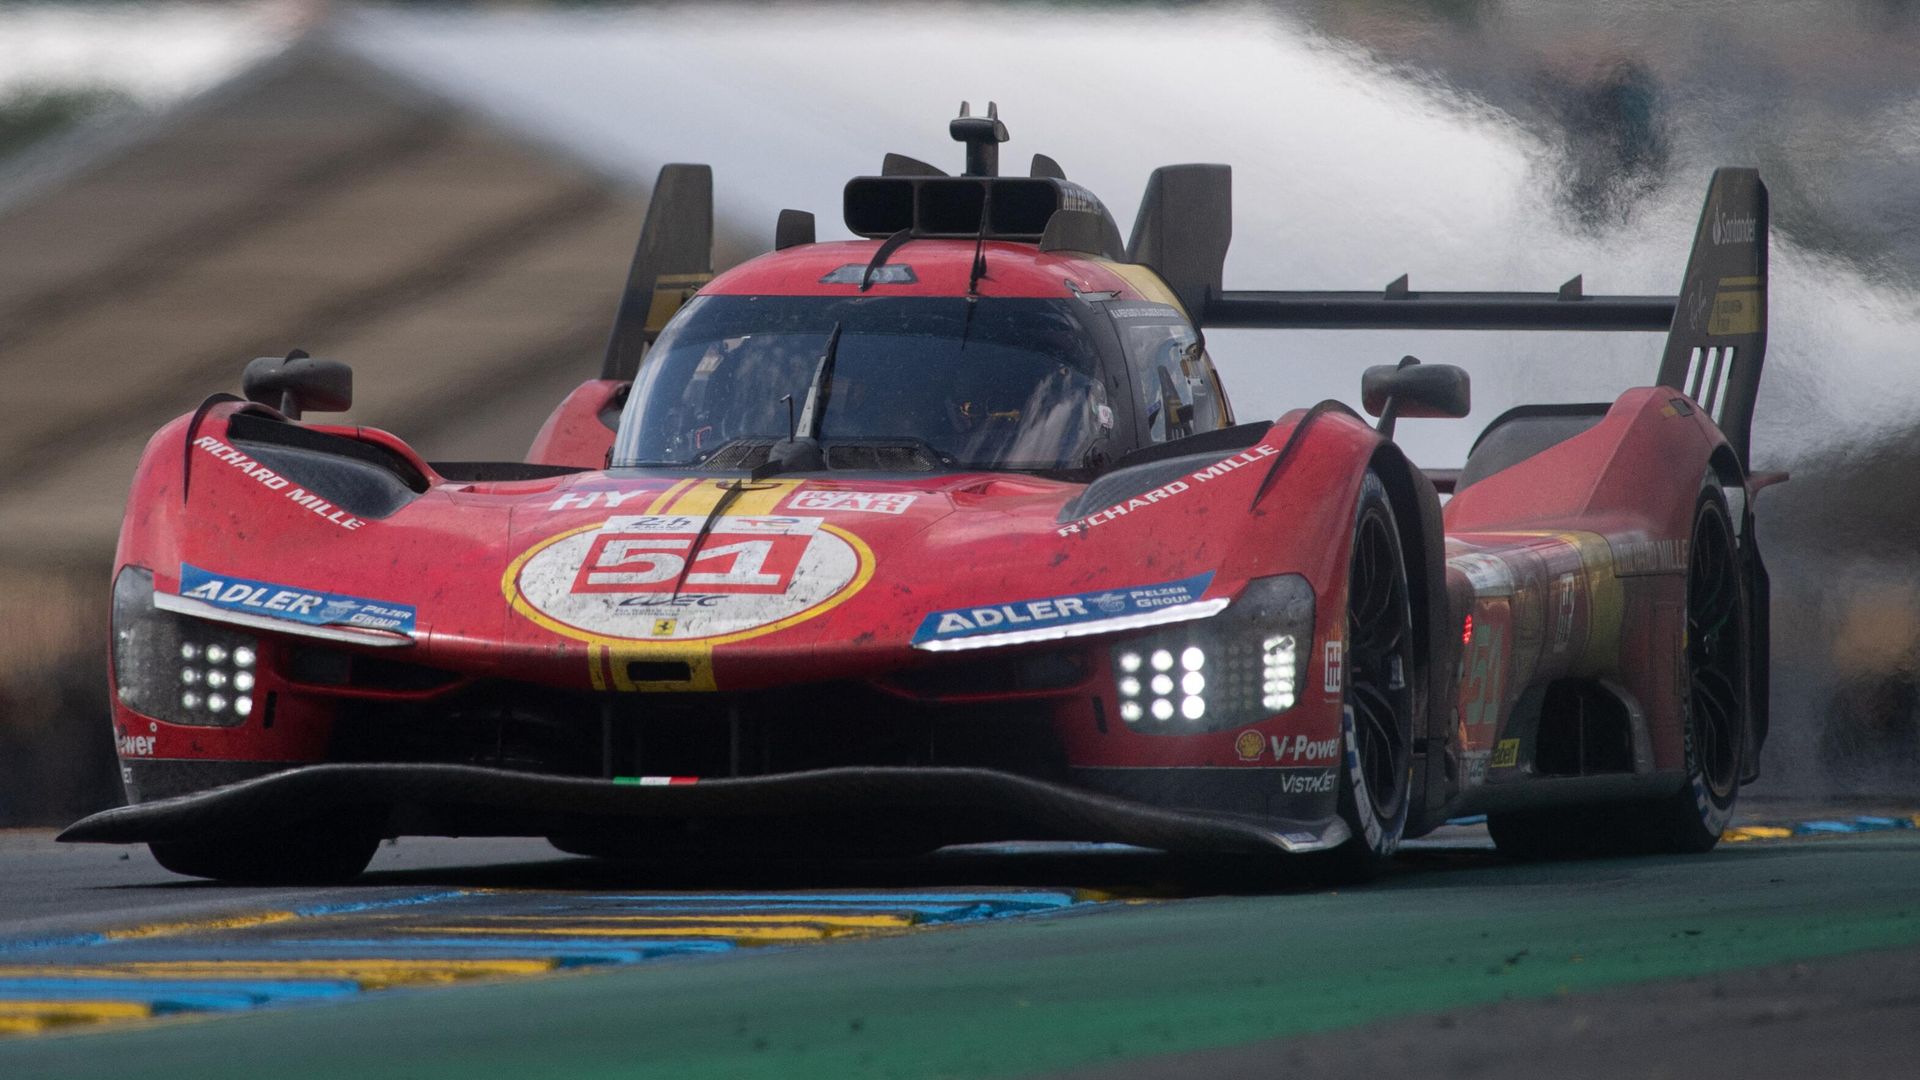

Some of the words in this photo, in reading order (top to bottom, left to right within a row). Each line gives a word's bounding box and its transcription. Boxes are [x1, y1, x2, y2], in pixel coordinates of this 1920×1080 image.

[1192, 444, 1280, 482] MILLE
[193, 436, 289, 490] RICHARD
[286, 488, 366, 530] MILLE
[548, 490, 649, 511] HY
[586, 539, 781, 585] 51
[182, 580, 323, 615] ADLER
[1130, 586, 1187, 600] PELZER
[1136, 595, 1191, 608] GROUP
[350, 613, 402, 628] GROUP
[361, 605, 412, 619] PELZER
[937, 597, 1088, 634] ADLER
[1271, 735, 1340, 761] V-Power
